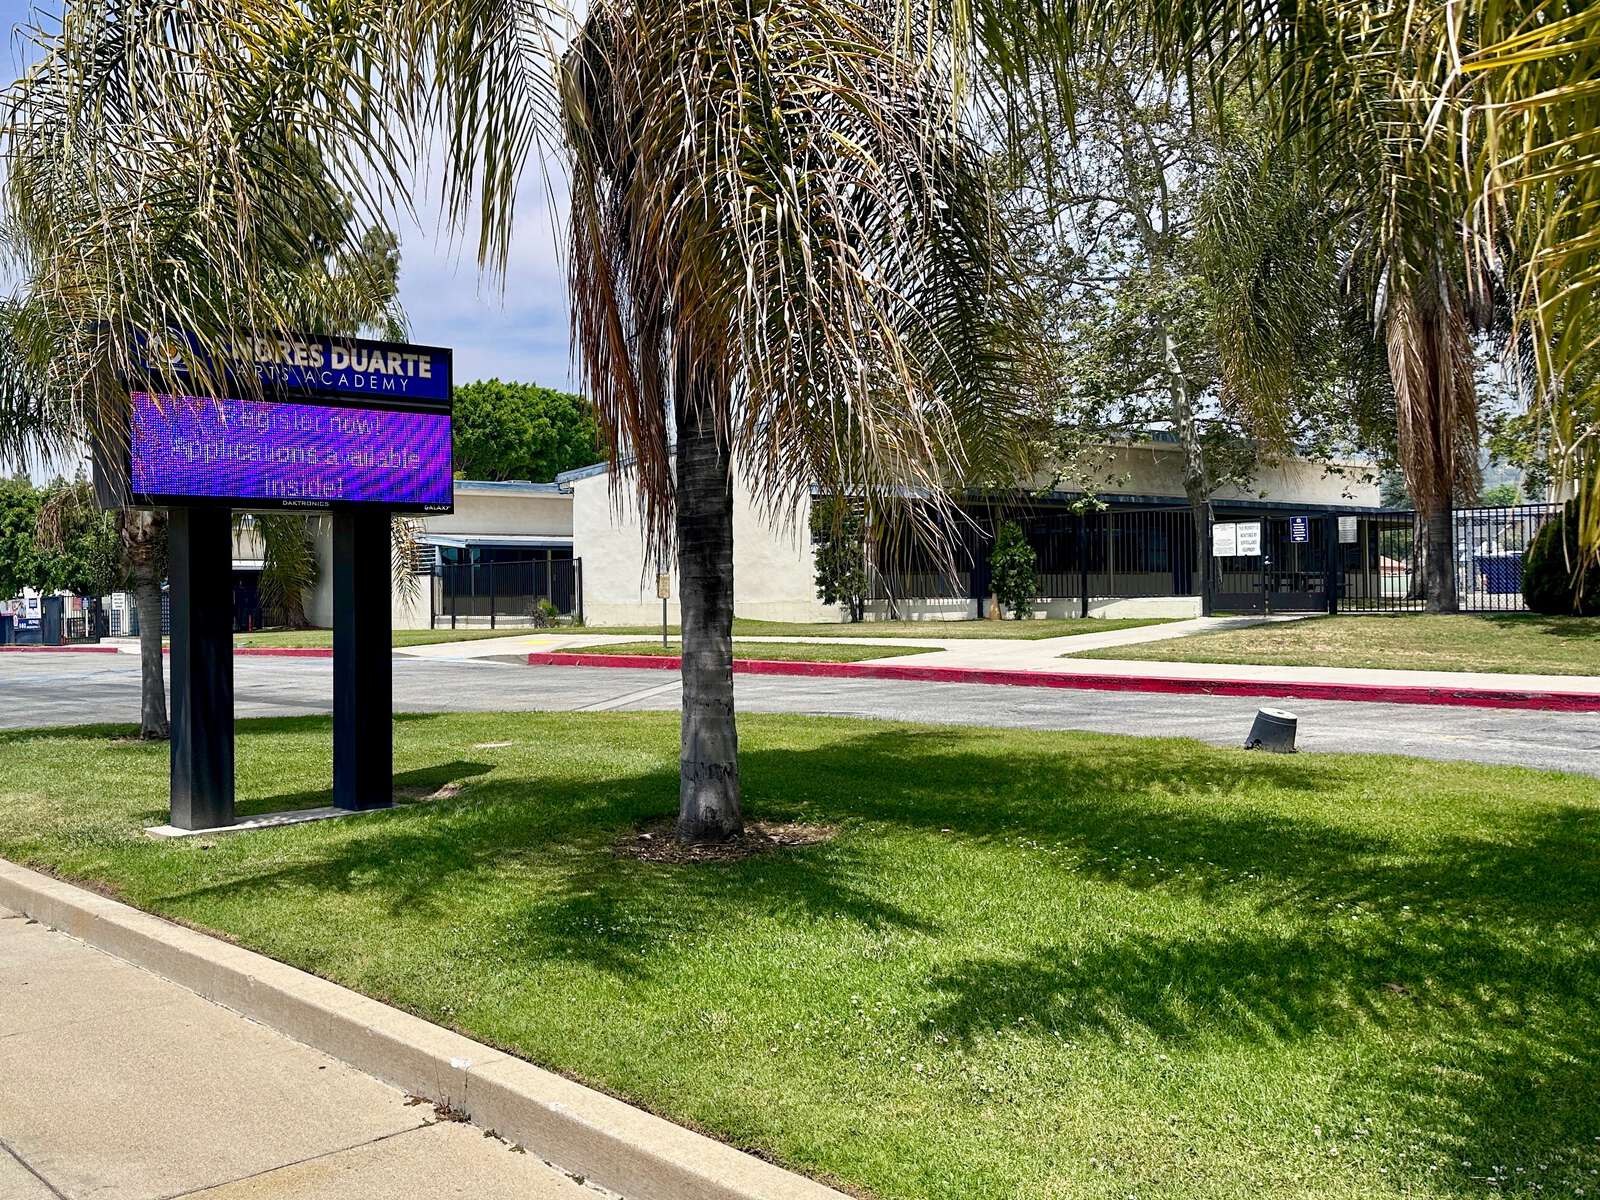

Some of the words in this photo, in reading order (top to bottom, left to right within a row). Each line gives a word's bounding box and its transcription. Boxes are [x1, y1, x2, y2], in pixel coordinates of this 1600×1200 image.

[331, 345, 432, 379] DUARTE
[304, 370, 408, 391] ACADEMY
[264, 473, 344, 498] inside!
[281, 500, 330, 508] DAKTRONICS
